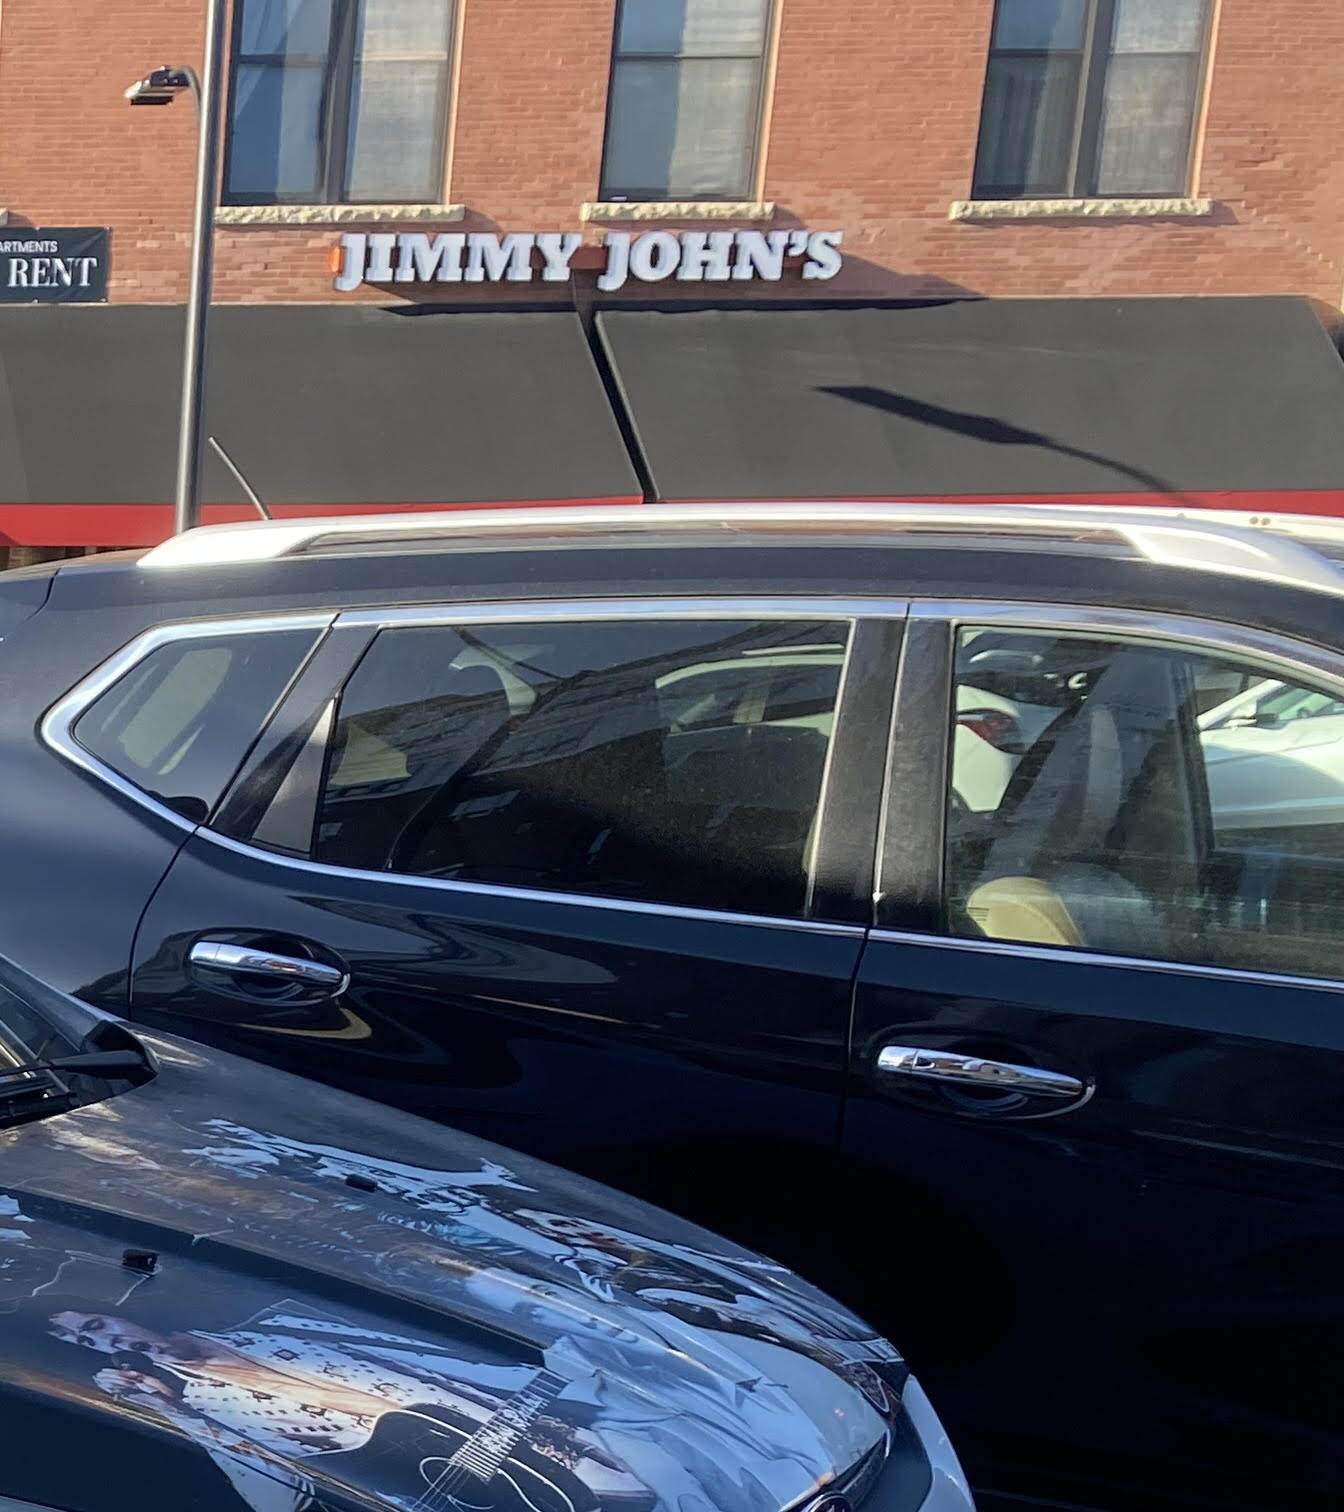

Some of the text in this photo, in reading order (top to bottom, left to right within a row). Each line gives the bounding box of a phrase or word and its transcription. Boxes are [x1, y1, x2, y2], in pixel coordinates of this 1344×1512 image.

[7, 256, 98, 288] RENT
[334, 229, 845, 292] JIMMY JOHN'S
